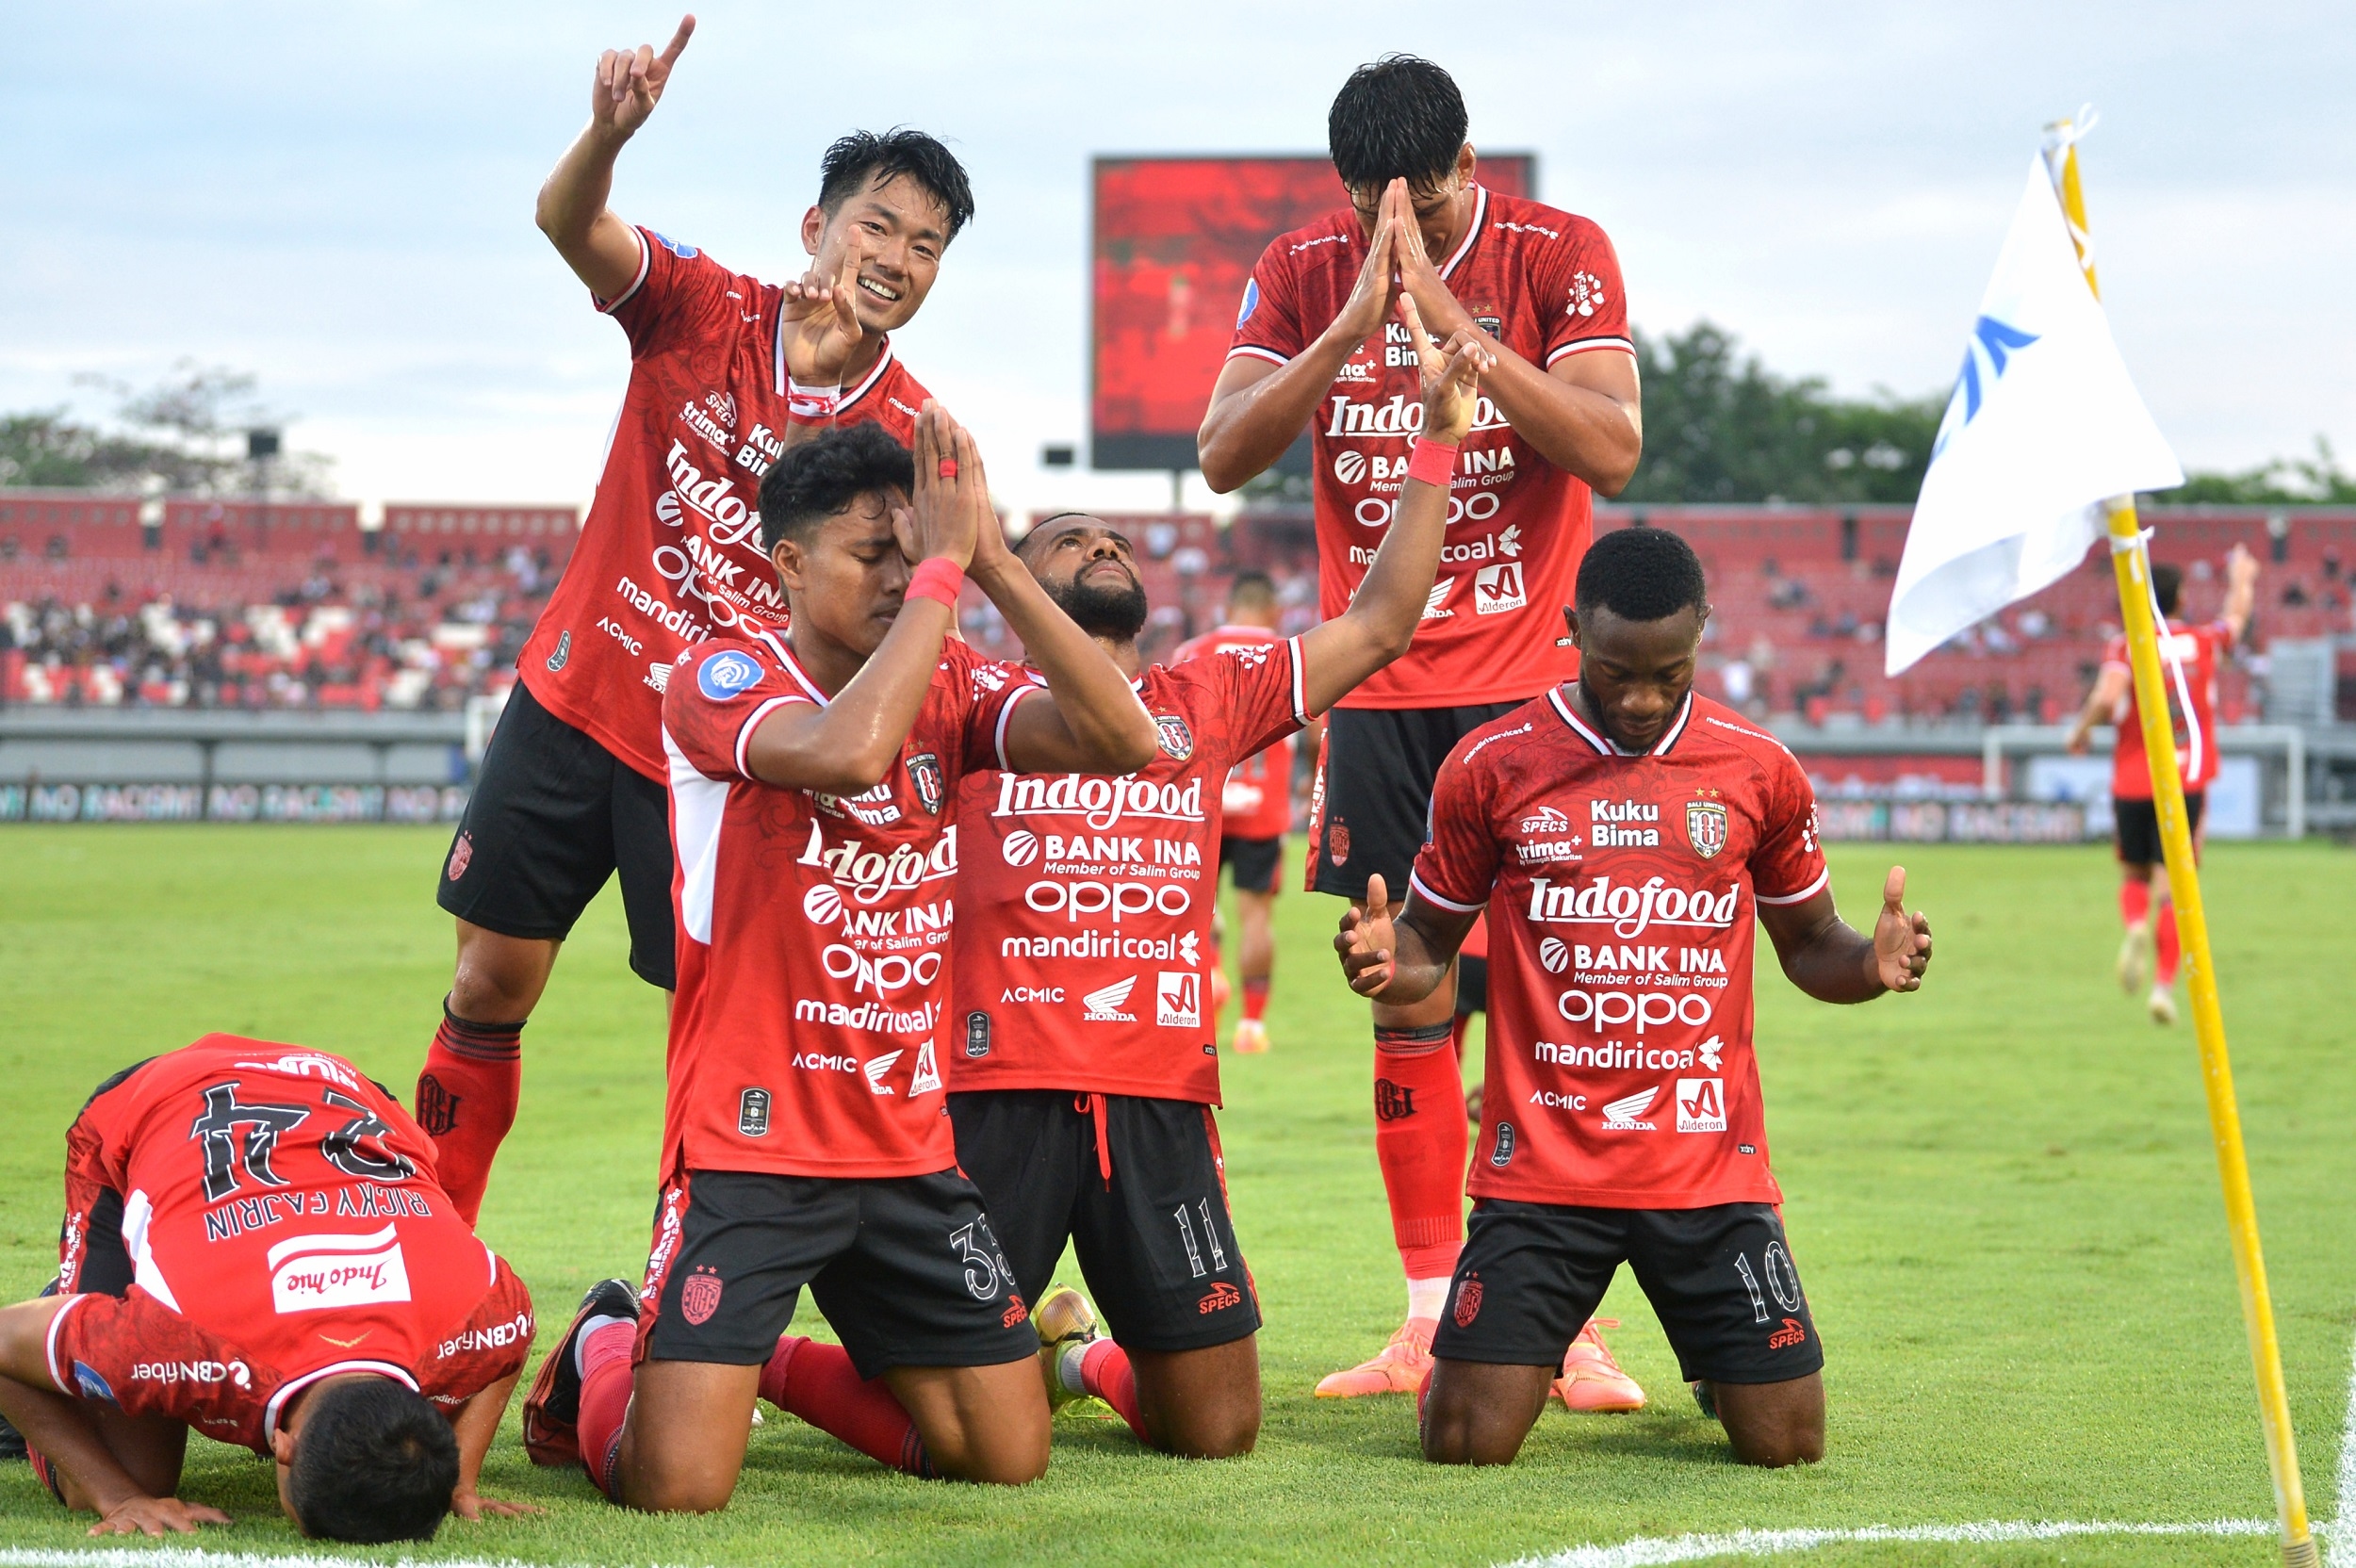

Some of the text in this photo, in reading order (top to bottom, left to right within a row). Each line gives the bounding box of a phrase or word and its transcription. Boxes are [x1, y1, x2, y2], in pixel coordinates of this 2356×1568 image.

[705, 394, 736, 428] SPECS
[1464, 447, 1515, 475] INA
[1450, 477, 1477, 489] alim
[1481, 470, 1515, 486] Group
[718, 581, 750, 609] Salim
[751, 604, 789, 624] Group
[1479, 598, 1523, 612] Alderon
[596, 616, 643, 657] ACMIC
[1463, 728, 1524, 764] mandiriservices
[991, 772, 1204, 831] Indofood
[1591, 799, 1659, 822] Kuku
[1703, 802, 1726, 811] UNITED
[1521, 821, 1568, 834] SPECS
[1592, 825, 1659, 847] Bima
[1045, 835, 1202, 866] BANK INA
[1526, 857, 1550, 865] Trimegah
[1551, 854, 1583, 862] Sekuritas
[1043, 862, 1201, 882] Member of Salim Group
[1024, 880, 1190, 923] oppo
[1527, 875, 1740, 939] Indofood
[906, 899, 954, 934] INA
[871, 939, 883, 951] of
[886, 936, 923, 950] Salim
[1002, 929, 1176, 960] mandiricoal
[822, 943, 941, 999] oppo
[1574, 945, 1727, 973] BANK INA
[1574, 972, 1728, 989] Member of Salim Group
[1001, 987, 1065, 1003] ACMIC
[1084, 1012, 1137, 1022] HONDA
[1158, 1014, 1197, 1026] Alderon
[1559, 989, 1711, 1035] oppo
[792, 1052, 858, 1072] ACMIC
[1530, 1089, 1587, 1111] ACMIC
[1601, 1121, 1657, 1131] HONDA
[1678, 1119, 1724, 1131] Alderon
[190, 1081, 416, 1202] 24
[205, 1185, 432, 1242] RICKY FAJRIN
[1174, 1197, 1228, 1279] 11
[1734, 1240, 1800, 1323] 10
[1199, 1291, 1241, 1315] SPECS
[1768, 1329, 1805, 1350] SPECS
